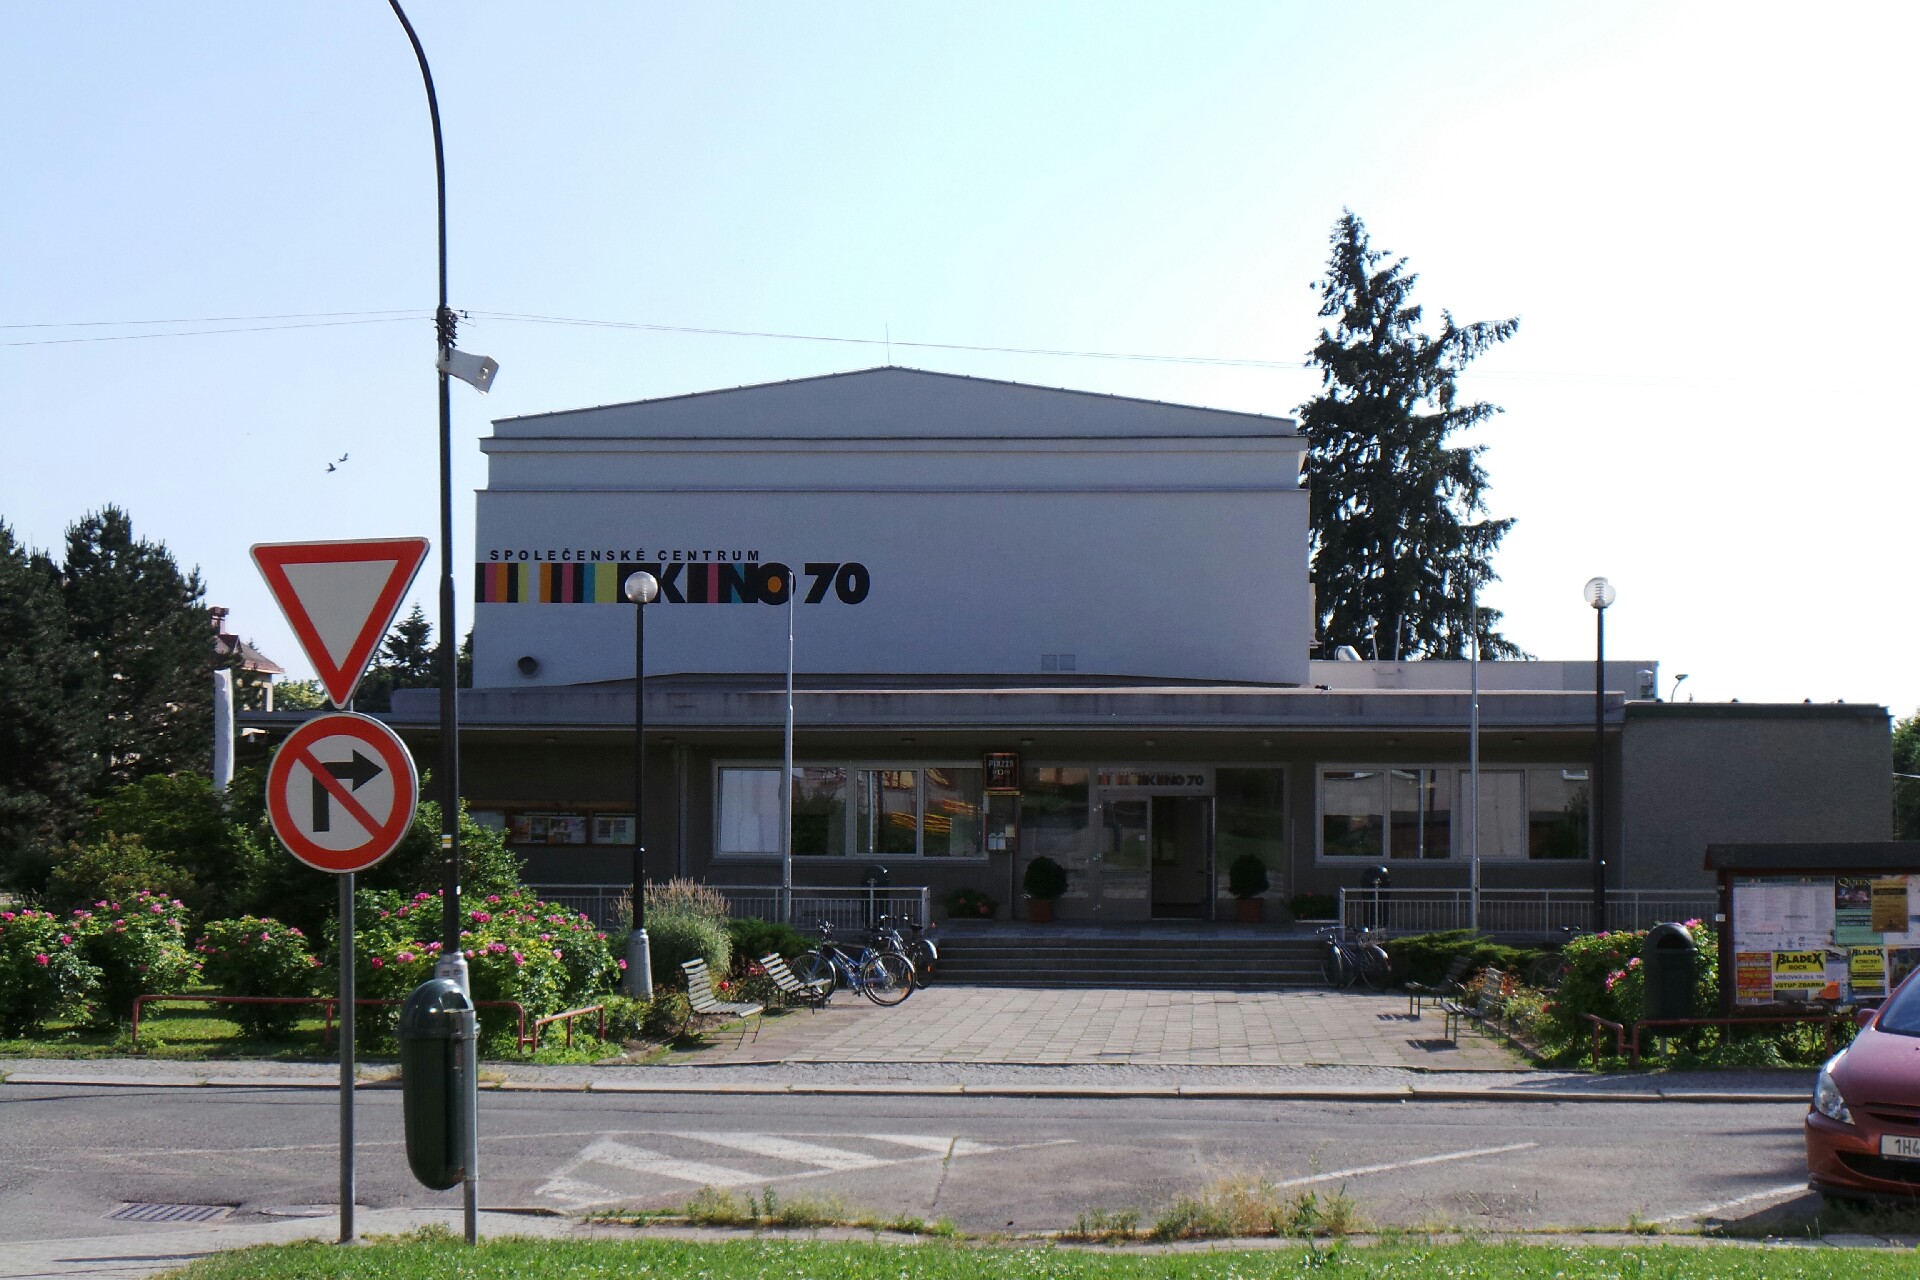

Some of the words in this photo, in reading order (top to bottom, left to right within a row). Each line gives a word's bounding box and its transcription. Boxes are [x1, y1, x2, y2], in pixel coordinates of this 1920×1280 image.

[490, 548, 646, 561] SPOLEČENSKÉ
[657, 550, 760, 561] CENTRUM
[632, 561, 796, 605] KINO
[804, 561, 871, 605] 70
[988, 759, 1014, 768] PIAZZA
[1187, 775, 1205, 786] 70
